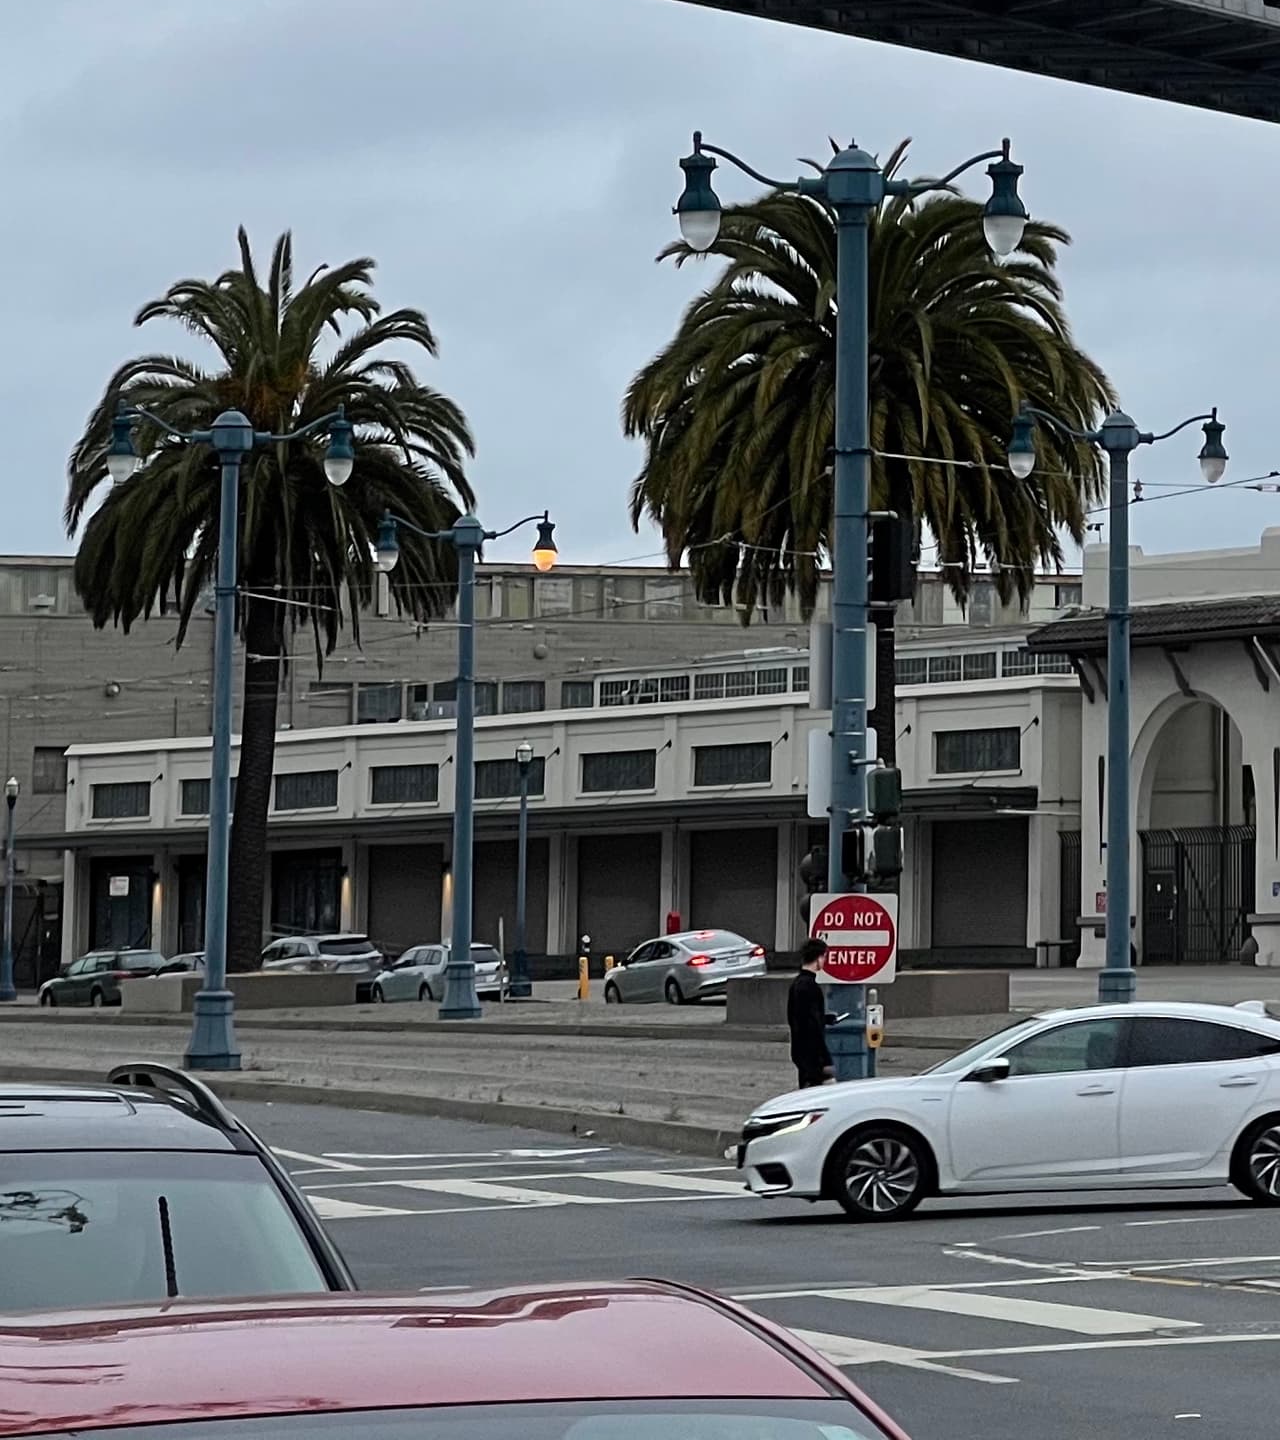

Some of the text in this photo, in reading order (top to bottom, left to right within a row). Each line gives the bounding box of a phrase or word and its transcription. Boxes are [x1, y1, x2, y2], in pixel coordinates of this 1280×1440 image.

[823, 911, 884, 927] DO NOT
[828, 950, 877, 966] ENTER
